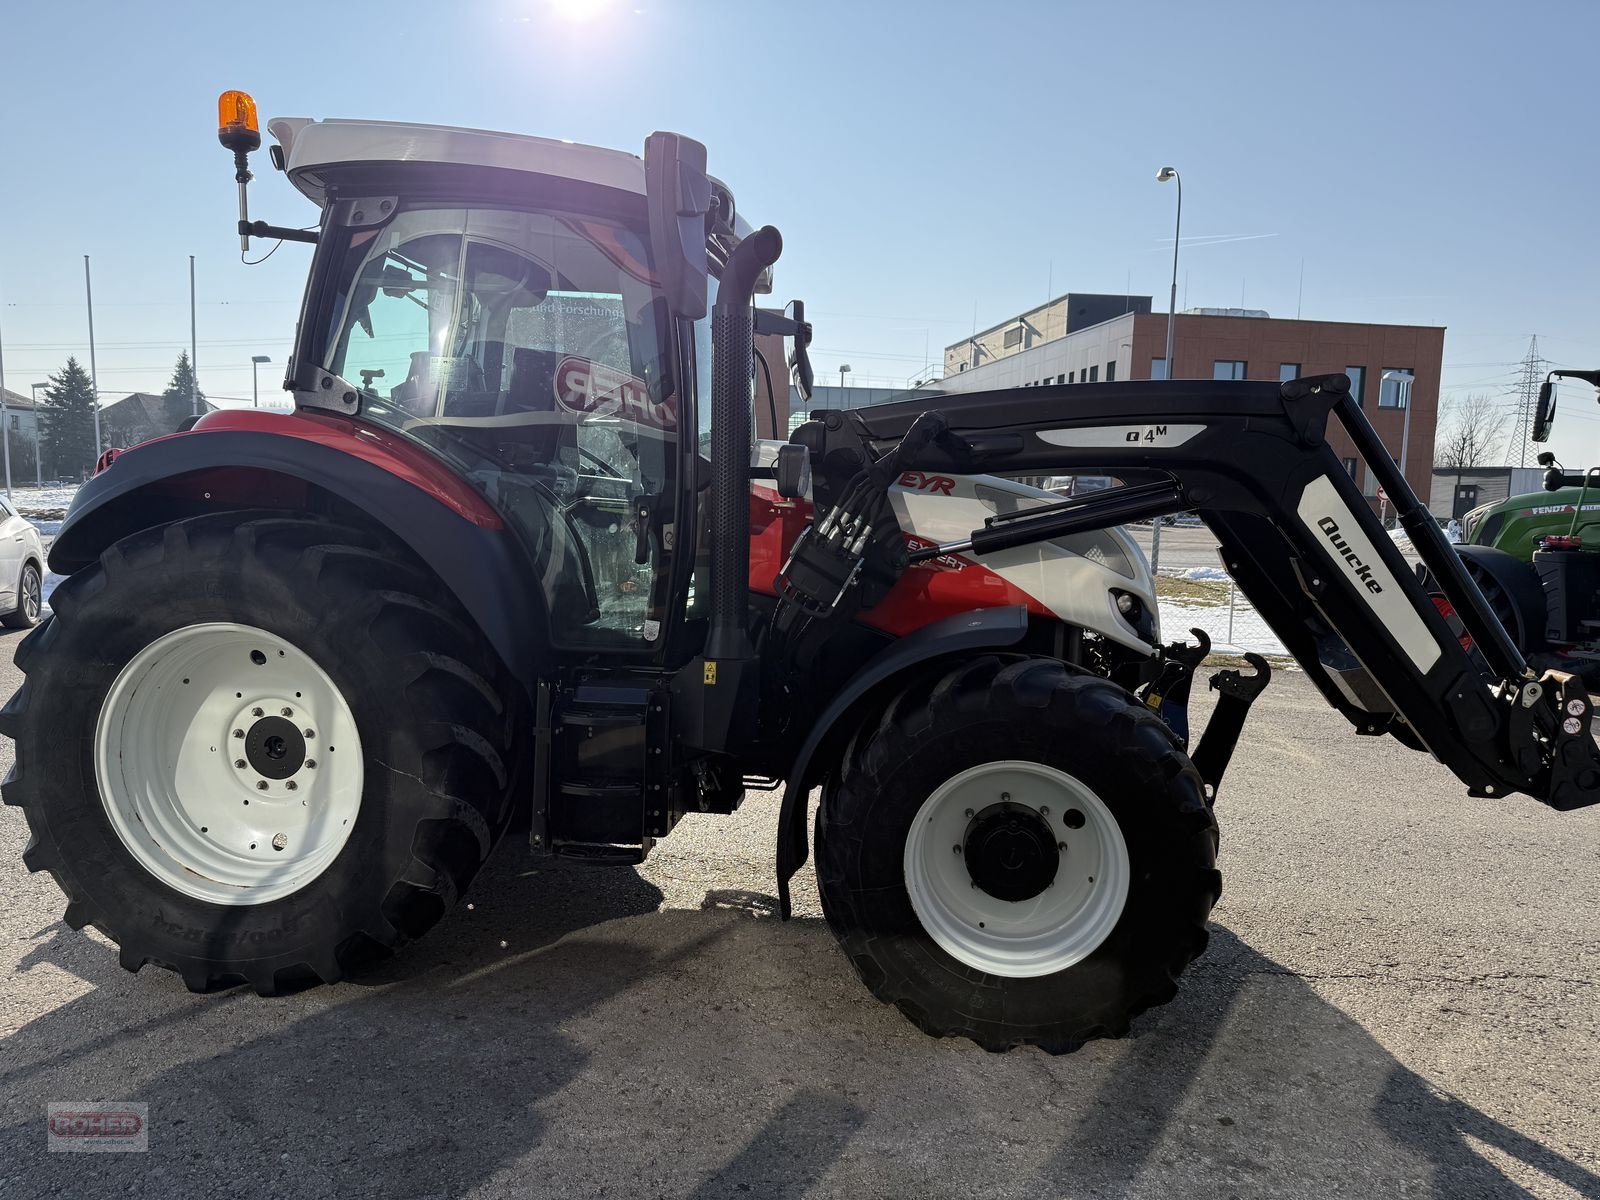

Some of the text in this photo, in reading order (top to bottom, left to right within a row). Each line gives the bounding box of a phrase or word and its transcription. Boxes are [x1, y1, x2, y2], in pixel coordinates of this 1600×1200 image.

[898, 472, 956, 496] EYR
[1532, 504, 1568, 515] FENDT
[907, 539, 967, 571] EXERT
[1317, 516, 1383, 594] Quicke
